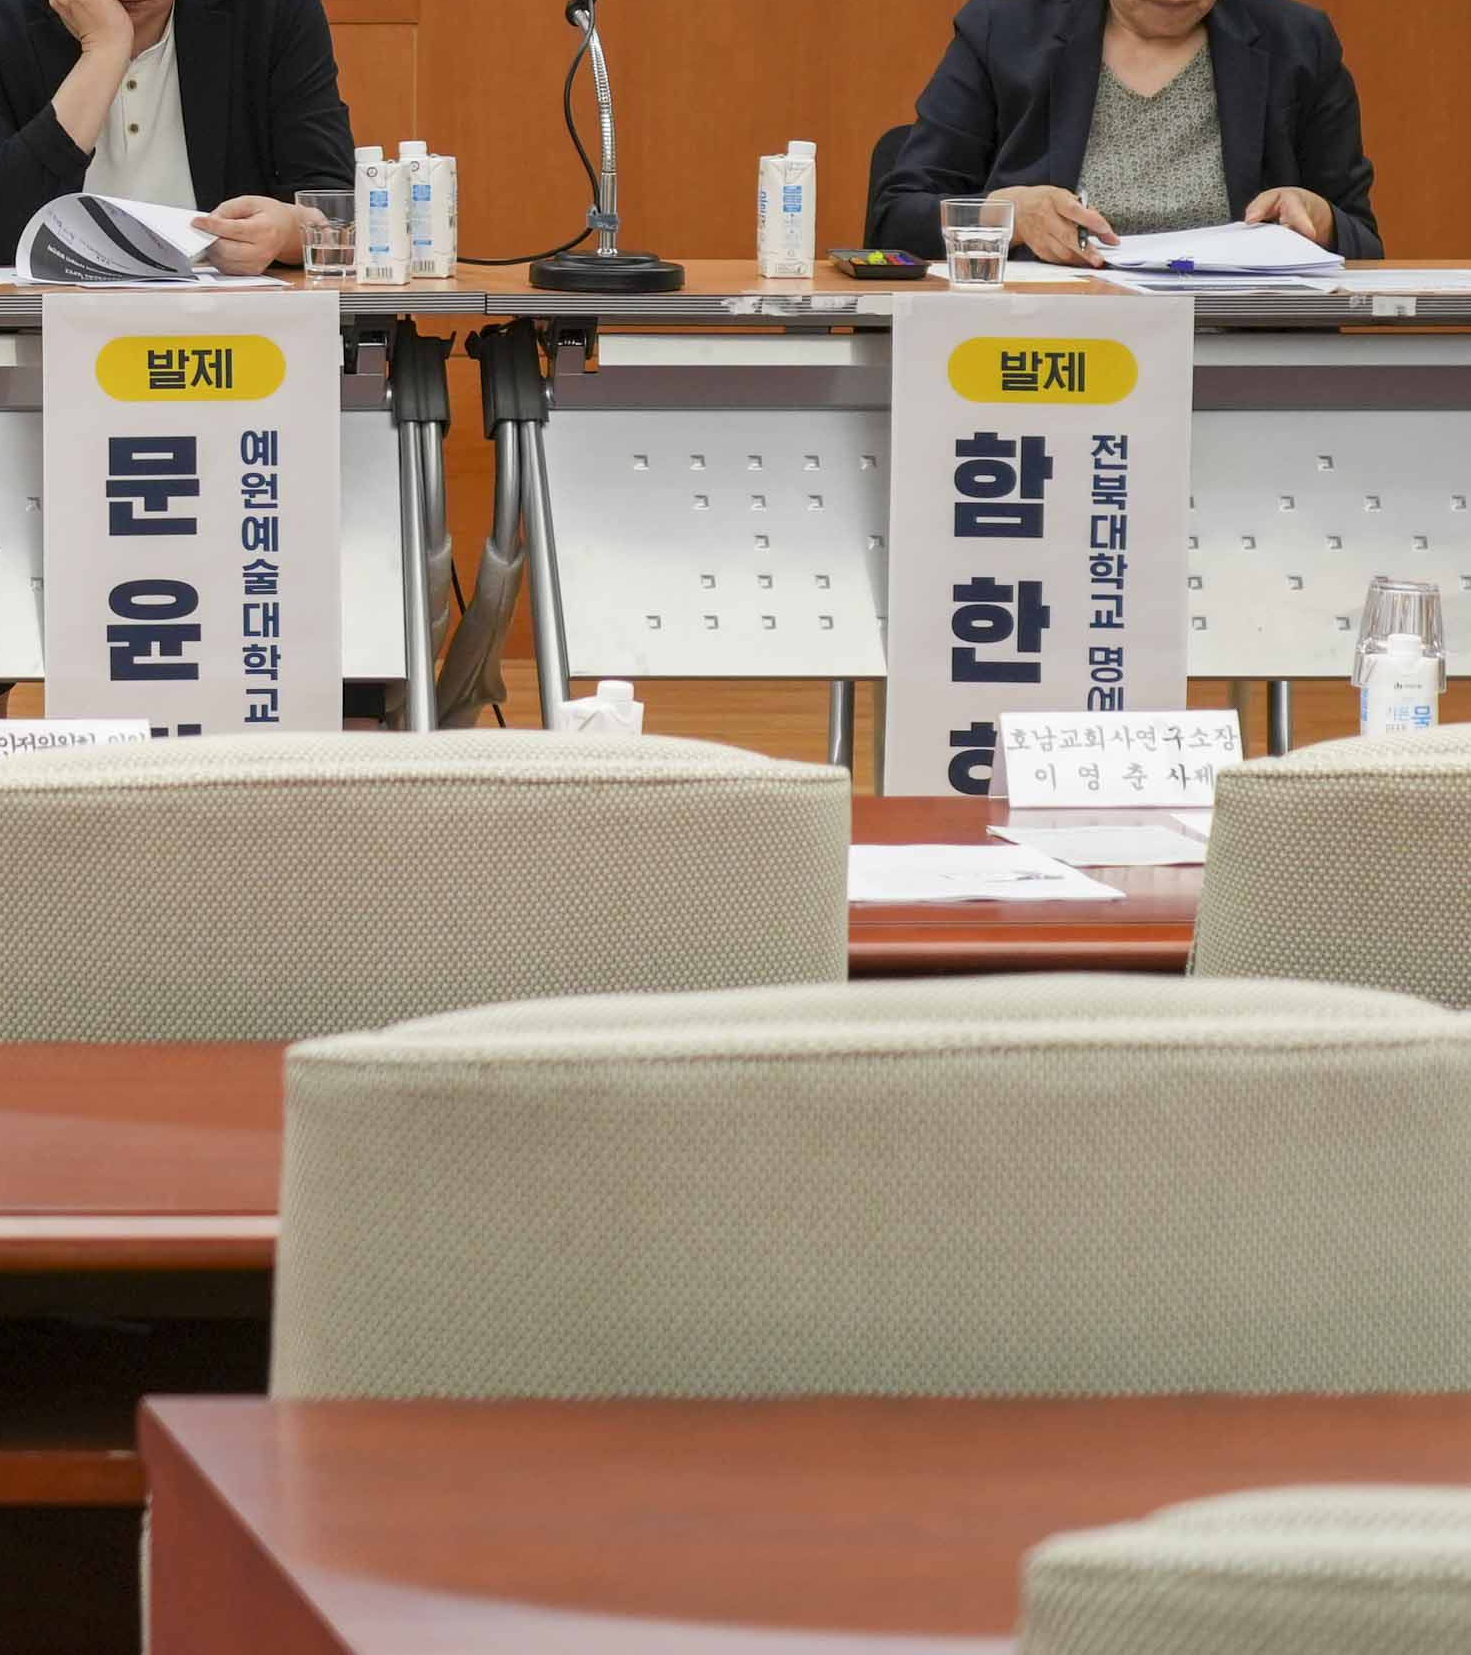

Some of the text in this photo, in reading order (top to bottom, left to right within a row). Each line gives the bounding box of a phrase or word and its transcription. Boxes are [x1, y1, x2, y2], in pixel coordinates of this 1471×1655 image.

[148, 349, 232, 389] 발제
[1001, 352, 1084, 392] 발제
[106, 436, 201, 737] 문윤
[241, 431, 281, 722] 예원예술대학교
[1090, 435, 1127, 628] 전북대학교
[1007, 725, 1238, 752] 호남교회사연구소장
